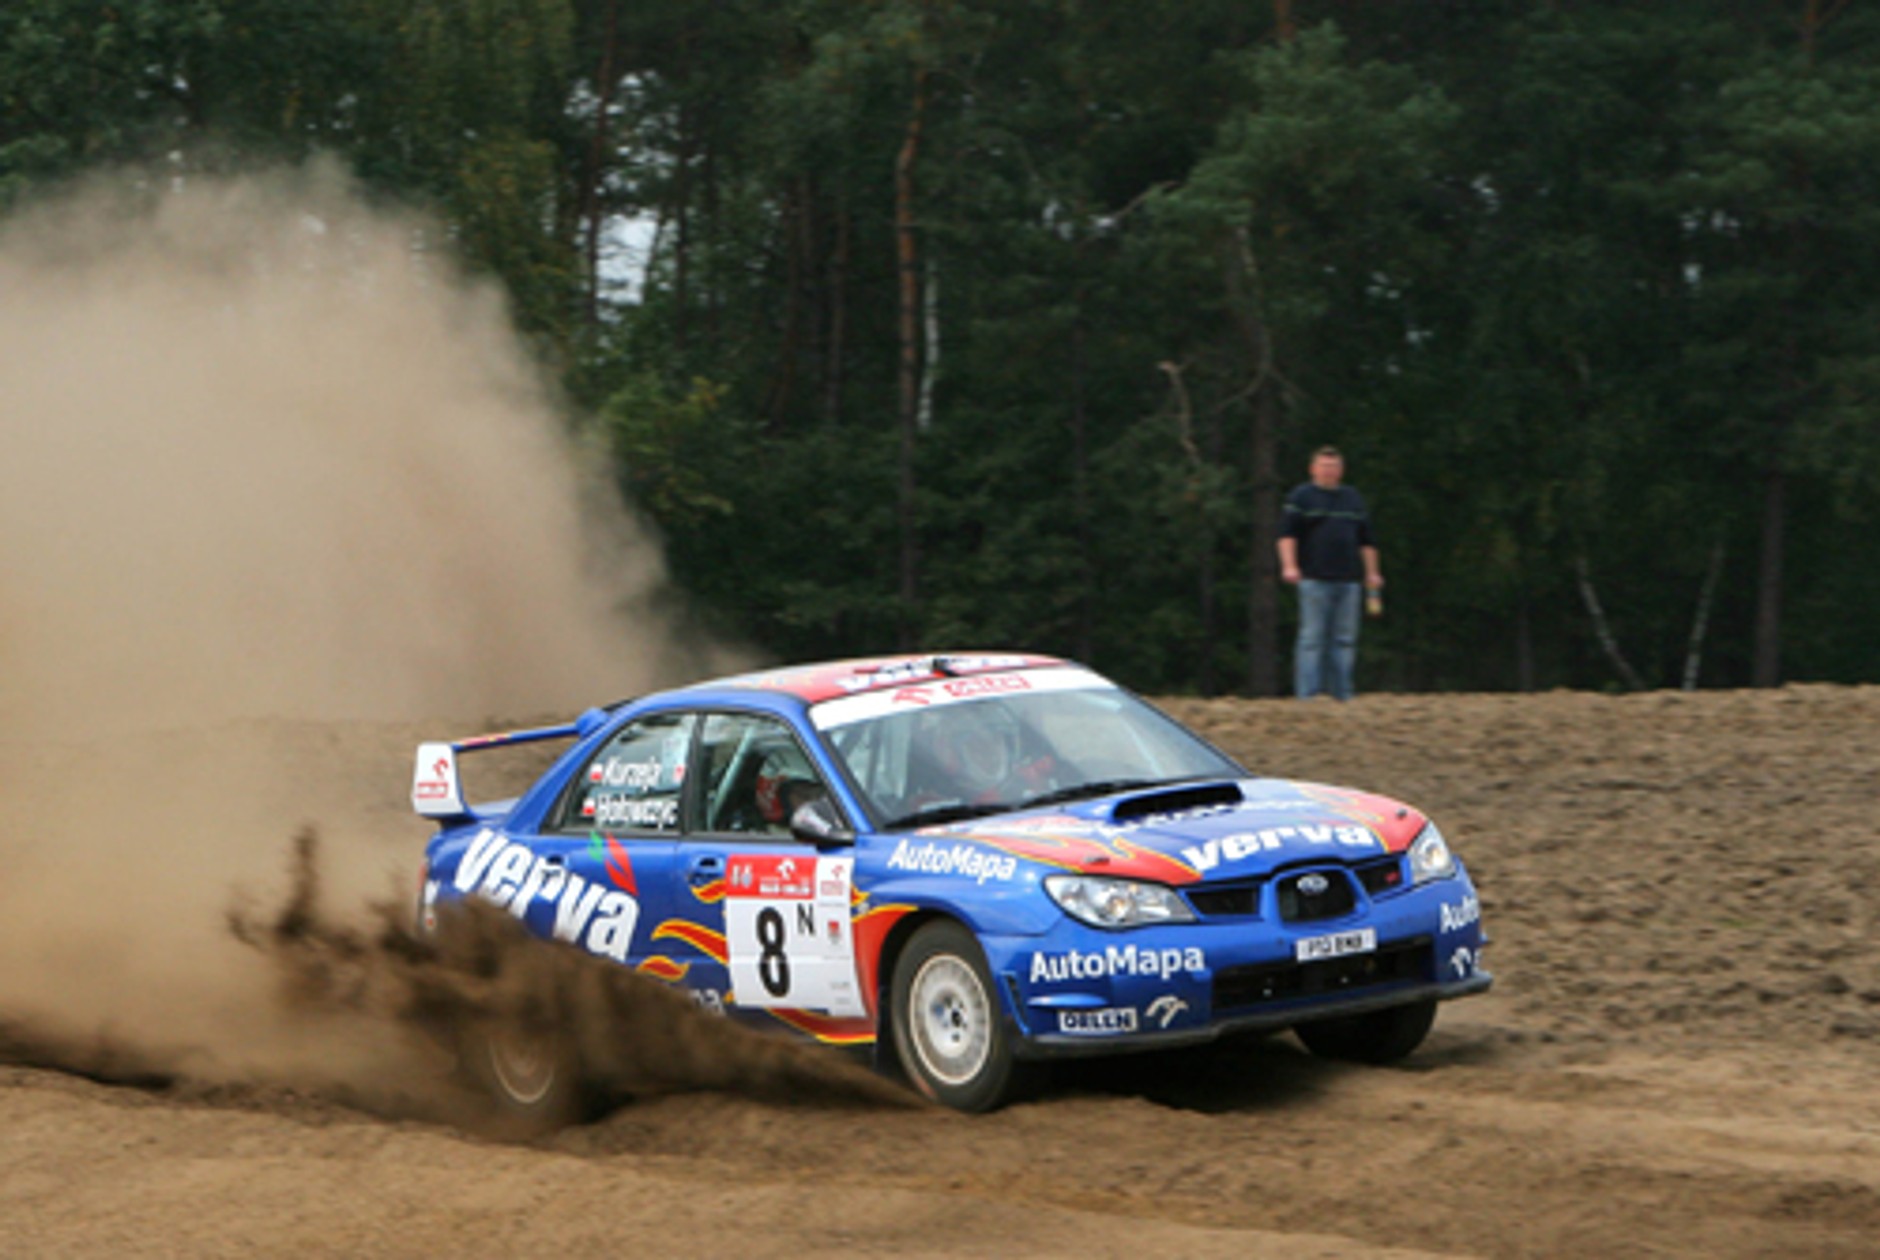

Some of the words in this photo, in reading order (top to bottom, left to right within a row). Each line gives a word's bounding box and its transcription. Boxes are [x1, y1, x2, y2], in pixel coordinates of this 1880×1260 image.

[887, 839, 1018, 884] AutoMapa
[1180, 825, 1376, 871] verva
[454, 828, 640, 963] verva
[797, 903, 816, 936] N
[757, 907, 790, 998] 8
[1030, 946, 1205, 983] AutoMapa
